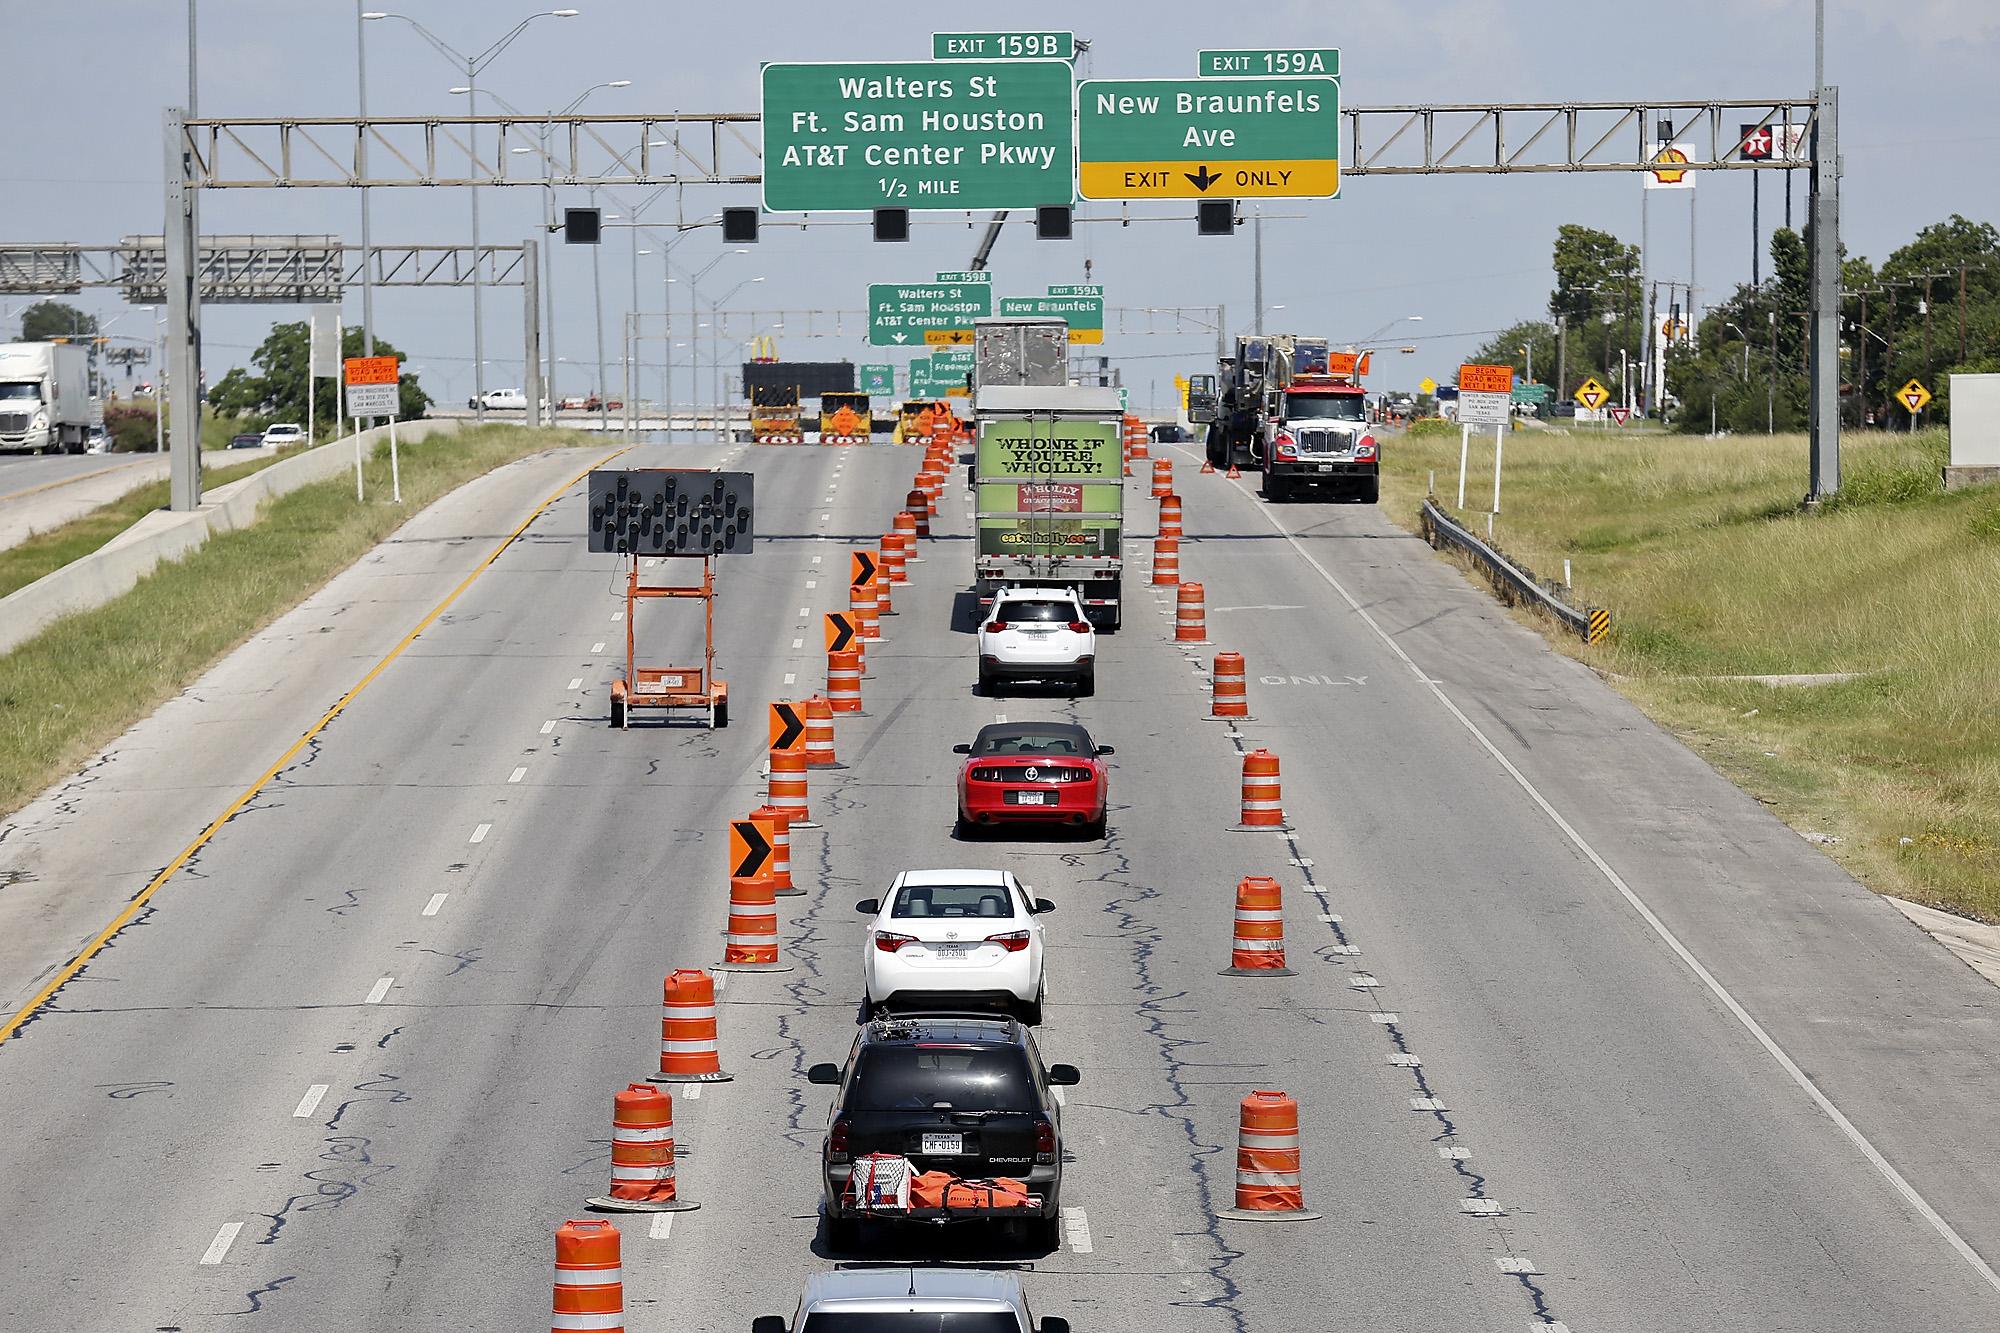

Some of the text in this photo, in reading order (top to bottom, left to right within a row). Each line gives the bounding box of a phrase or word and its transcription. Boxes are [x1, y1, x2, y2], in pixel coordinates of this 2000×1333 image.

[948, 35, 1058, 56] EXIT 159B
[1213, 52, 1325, 73] EXIT 159A
[839, 76, 997, 98] Walters St
[1097, 90, 1321, 115] New Braunfels
[792, 109, 1044, 133] Ft. Sam Houston
[1182, 126, 1236, 148] Ave
[782, 141, 1056, 170] AT&T Center Pkwy
[1124, 170, 1293, 187] EXIT ONLY
[918, 180, 960, 195] MILE
[960, 272, 986, 282] 159B
[897, 288, 963, 299] Walters St
[1073, 286, 1099, 295] 159A
[879, 302, 981, 312] Ft. Sam Houston
[1006, 301, 1097, 312] New Braunfels
[876, 316, 903, 326] AT&T
[908, 316, 949, 326] Center
[996, 438, 1105, 450] WHONK IF
[1011, 450, 1093, 462] YOU'RE
[1001, 462, 1103, 474] WHOLLY!
[1021, 485, 1080, 496] WHOLLY
[1259, 675, 1369, 686] ONLY
